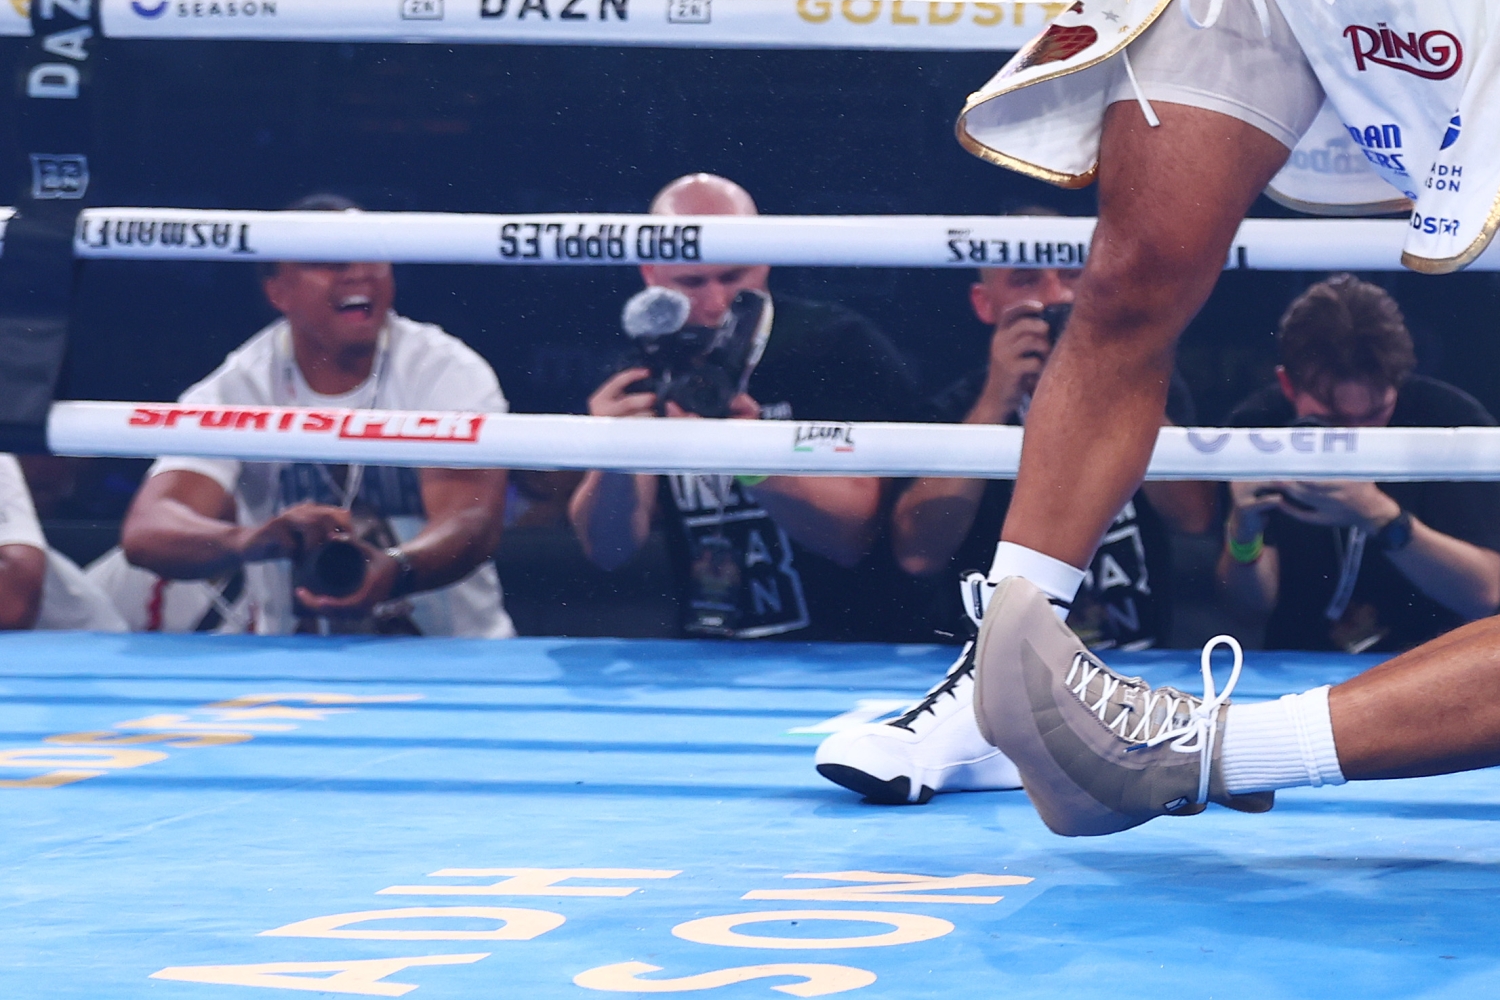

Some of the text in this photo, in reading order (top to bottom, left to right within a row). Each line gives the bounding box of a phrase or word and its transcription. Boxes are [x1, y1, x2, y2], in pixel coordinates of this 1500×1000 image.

[177, 3, 278, 18] SEASON
[1342, 24, 1463, 81] RING
[500, 222, 703, 260] BAD APPLES
[946, 238, 1090, 265] IGHTERS
